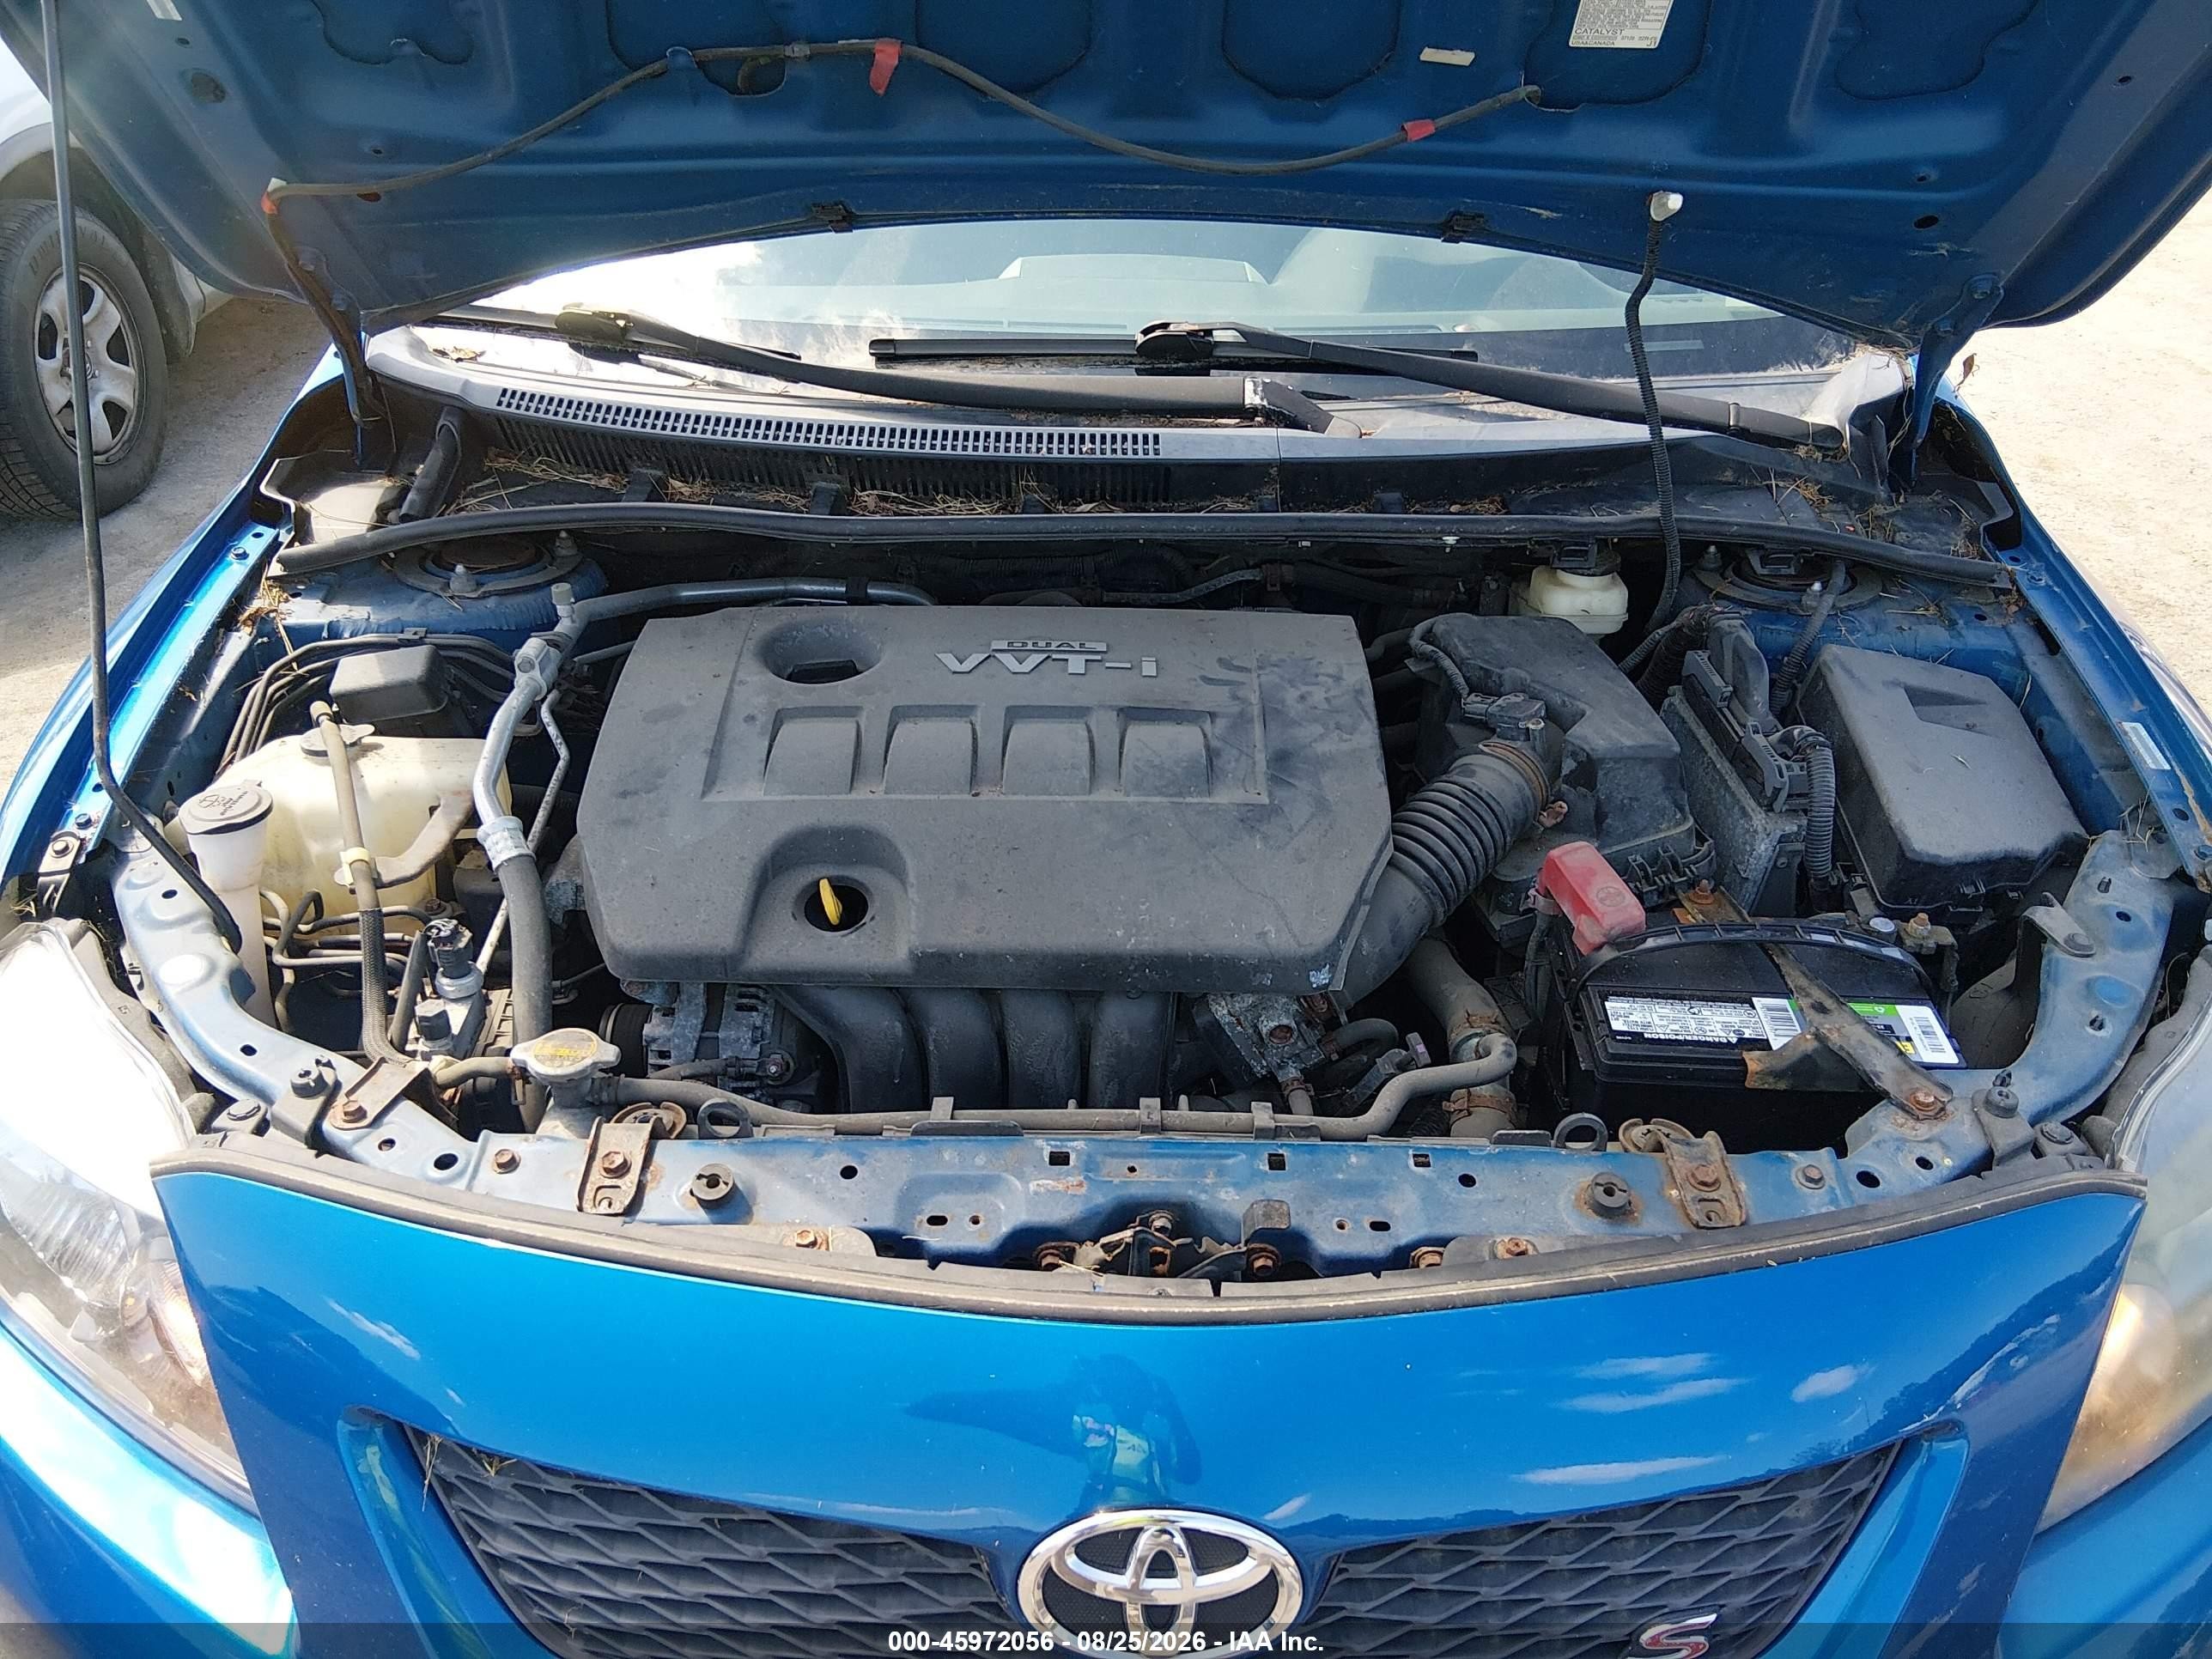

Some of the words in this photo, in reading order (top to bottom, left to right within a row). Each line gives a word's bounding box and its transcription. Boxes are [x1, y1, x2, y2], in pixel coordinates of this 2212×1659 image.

[1006, 641, 1098, 650] DUAL
[934, 653, 1158, 677] VVT-i
[1644, 1032, 1729, 1043] DANGER/POISON
[1627, 1613, 1717, 1659] S
